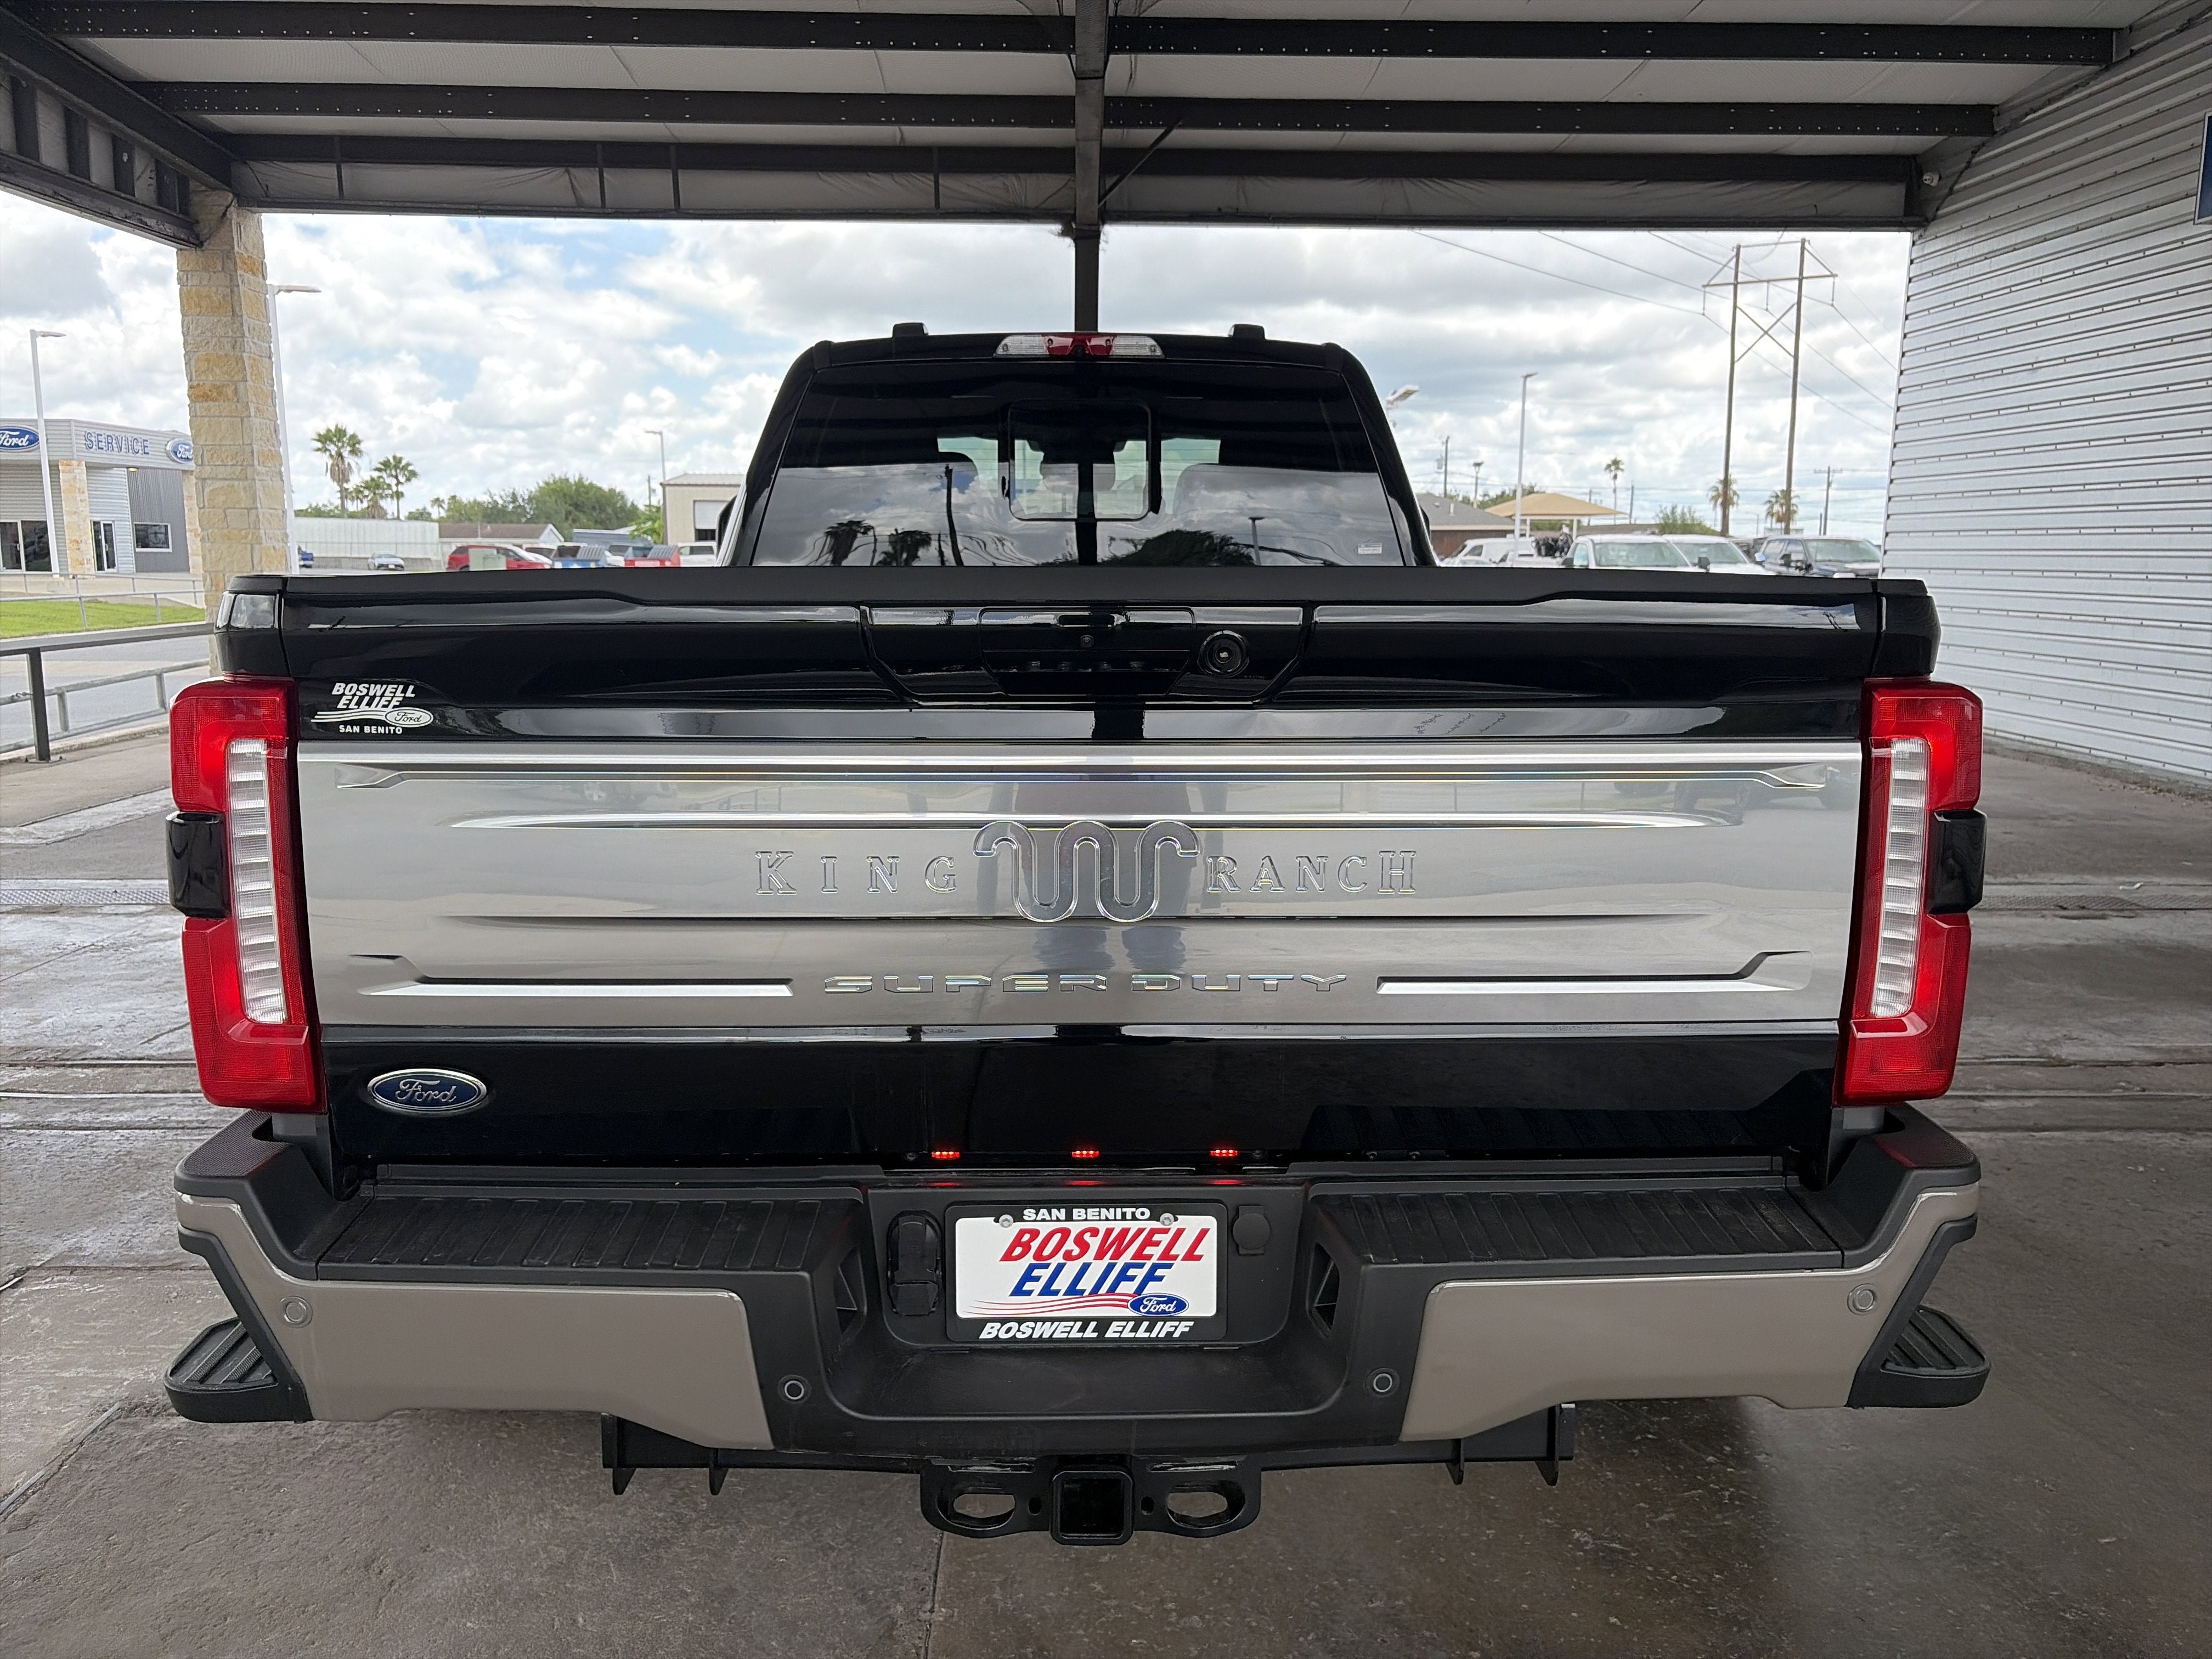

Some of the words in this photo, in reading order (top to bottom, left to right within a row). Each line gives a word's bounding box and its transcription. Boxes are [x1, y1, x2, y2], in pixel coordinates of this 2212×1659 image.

[0, 430, 29, 446] Ford
[84, 431, 150, 455] SERVICE
[177, 444, 193, 459] Ford
[331, 682, 415, 697] BOSWELL
[336, 696, 403, 709] ELLIFF
[394, 712, 422, 723] Ford
[339, 725, 360, 733] SAN
[364, 725, 403, 735] BENITO
[755, 851, 956, 895] KING
[1207, 850, 1417, 894] RANCH
[825, 974, 1107, 994] SUPER
[1131, 974, 1347, 992] DUTY
[395, 1079, 457, 1102] Ford
[1023, 1208, 1066, 1221] SAN
[1073, 1207, 1150, 1220] BENITO
[998, 1227, 1211, 1262] BOSWELL
[1009, 1262, 1175, 1297] ELLIFF
[1139, 1297, 1177, 1313] Ford
[979, 1321, 1099, 1340] BOSWELL
[1104, 1321, 1194, 1339] ELLIFF
